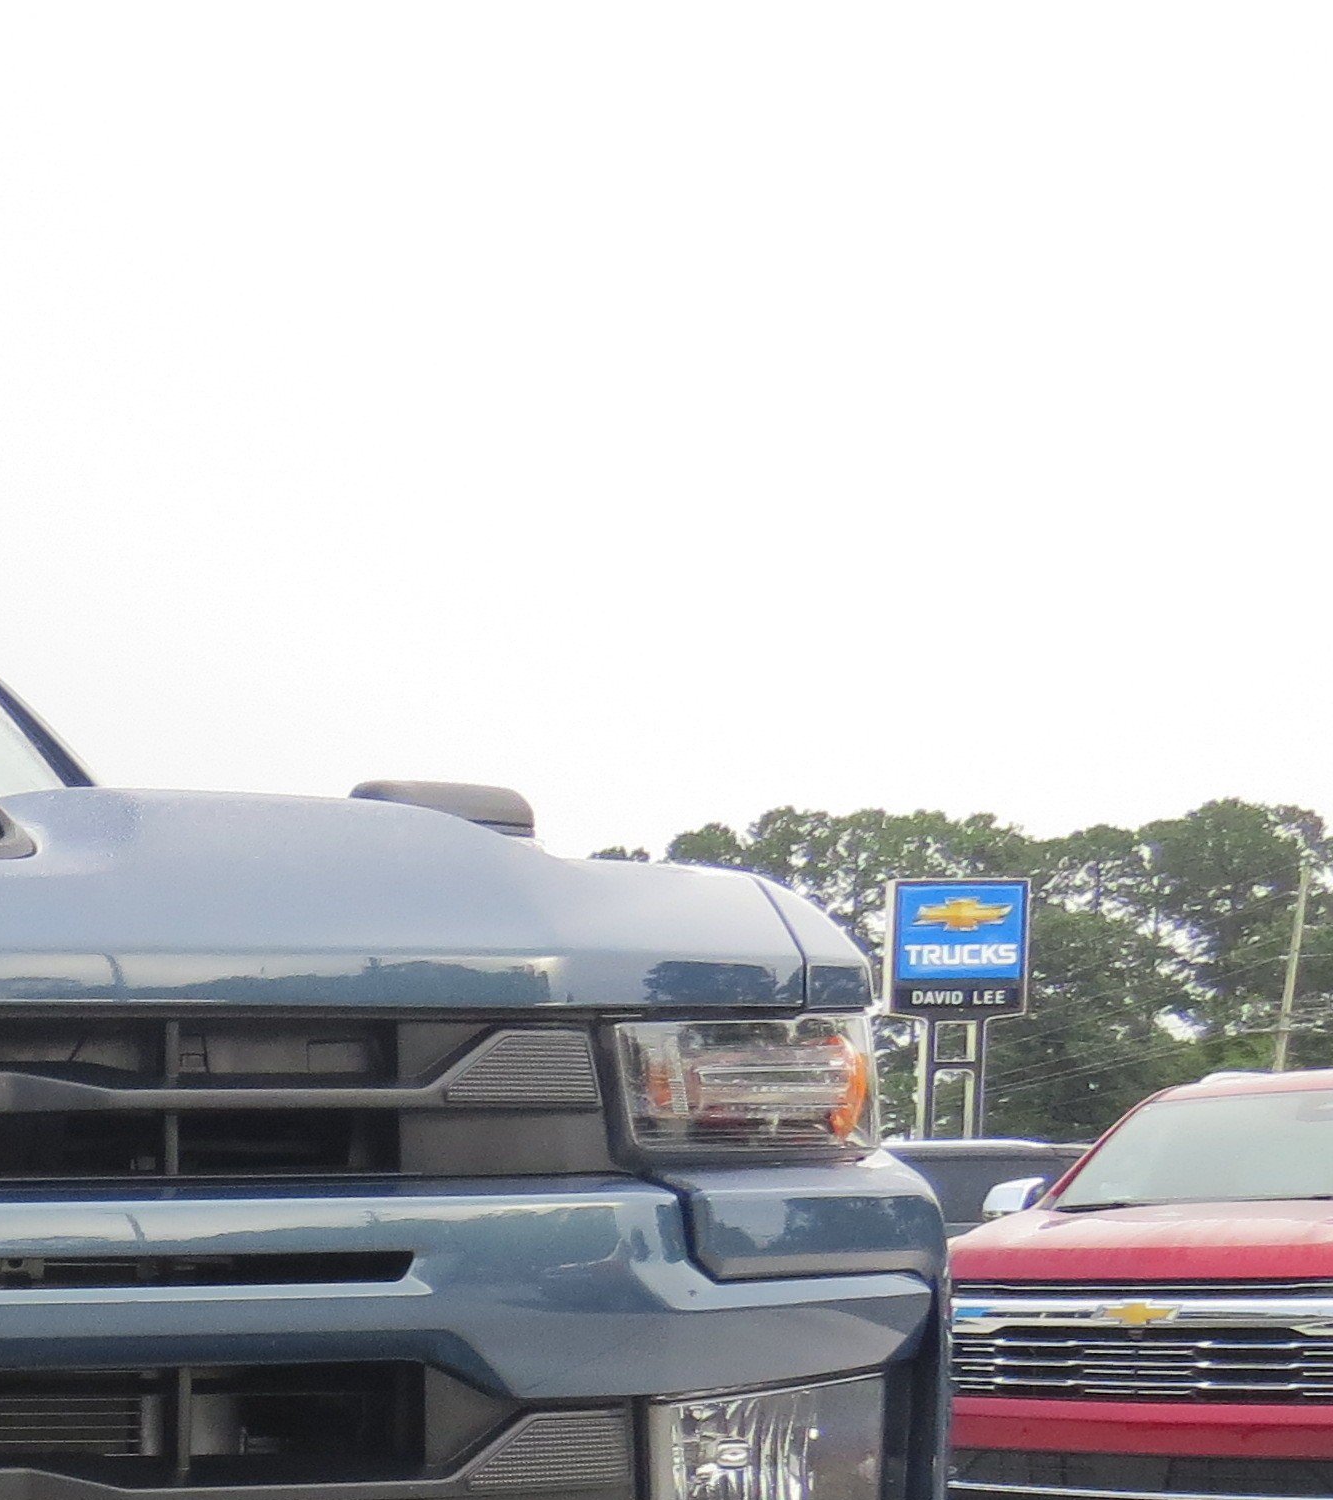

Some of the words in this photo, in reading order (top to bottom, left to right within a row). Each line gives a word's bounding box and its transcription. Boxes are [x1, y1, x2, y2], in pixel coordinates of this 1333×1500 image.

[904, 943, 1018, 966] TRUCKS
[910, 989, 964, 1005] DAVID
[972, 989, 1006, 1005] LEE
